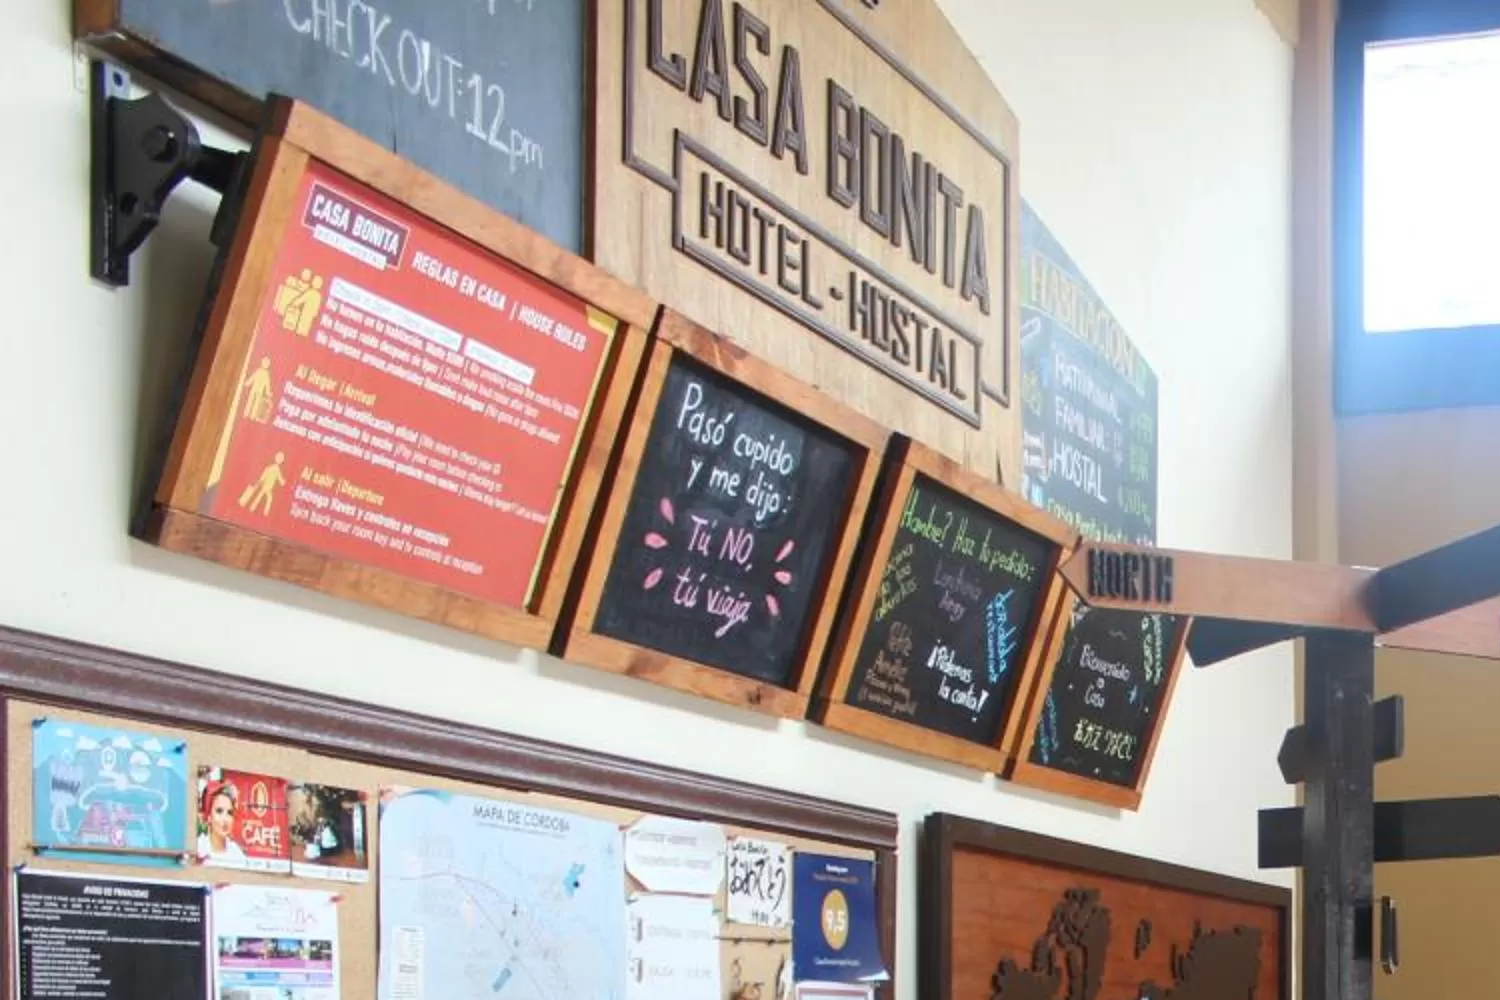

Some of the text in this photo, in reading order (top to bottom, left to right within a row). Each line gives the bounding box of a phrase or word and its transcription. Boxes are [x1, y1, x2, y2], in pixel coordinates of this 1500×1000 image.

[285, 0, 396, 86] CHECK
[646, 0, 990, 316] CASA BONITA
[312, 194, 350, 231] CASA
[351, 214, 399, 256] BONITA
[411, 250, 459, 289] REGLAS
[458, 278, 478, 298] EN
[677, 383, 793, 475] Pasó cupido
[709, 465, 741, 497] me
[1053, 437, 1108, 503] HOSTAL
[1086, 547, 1175, 604] NORTH
